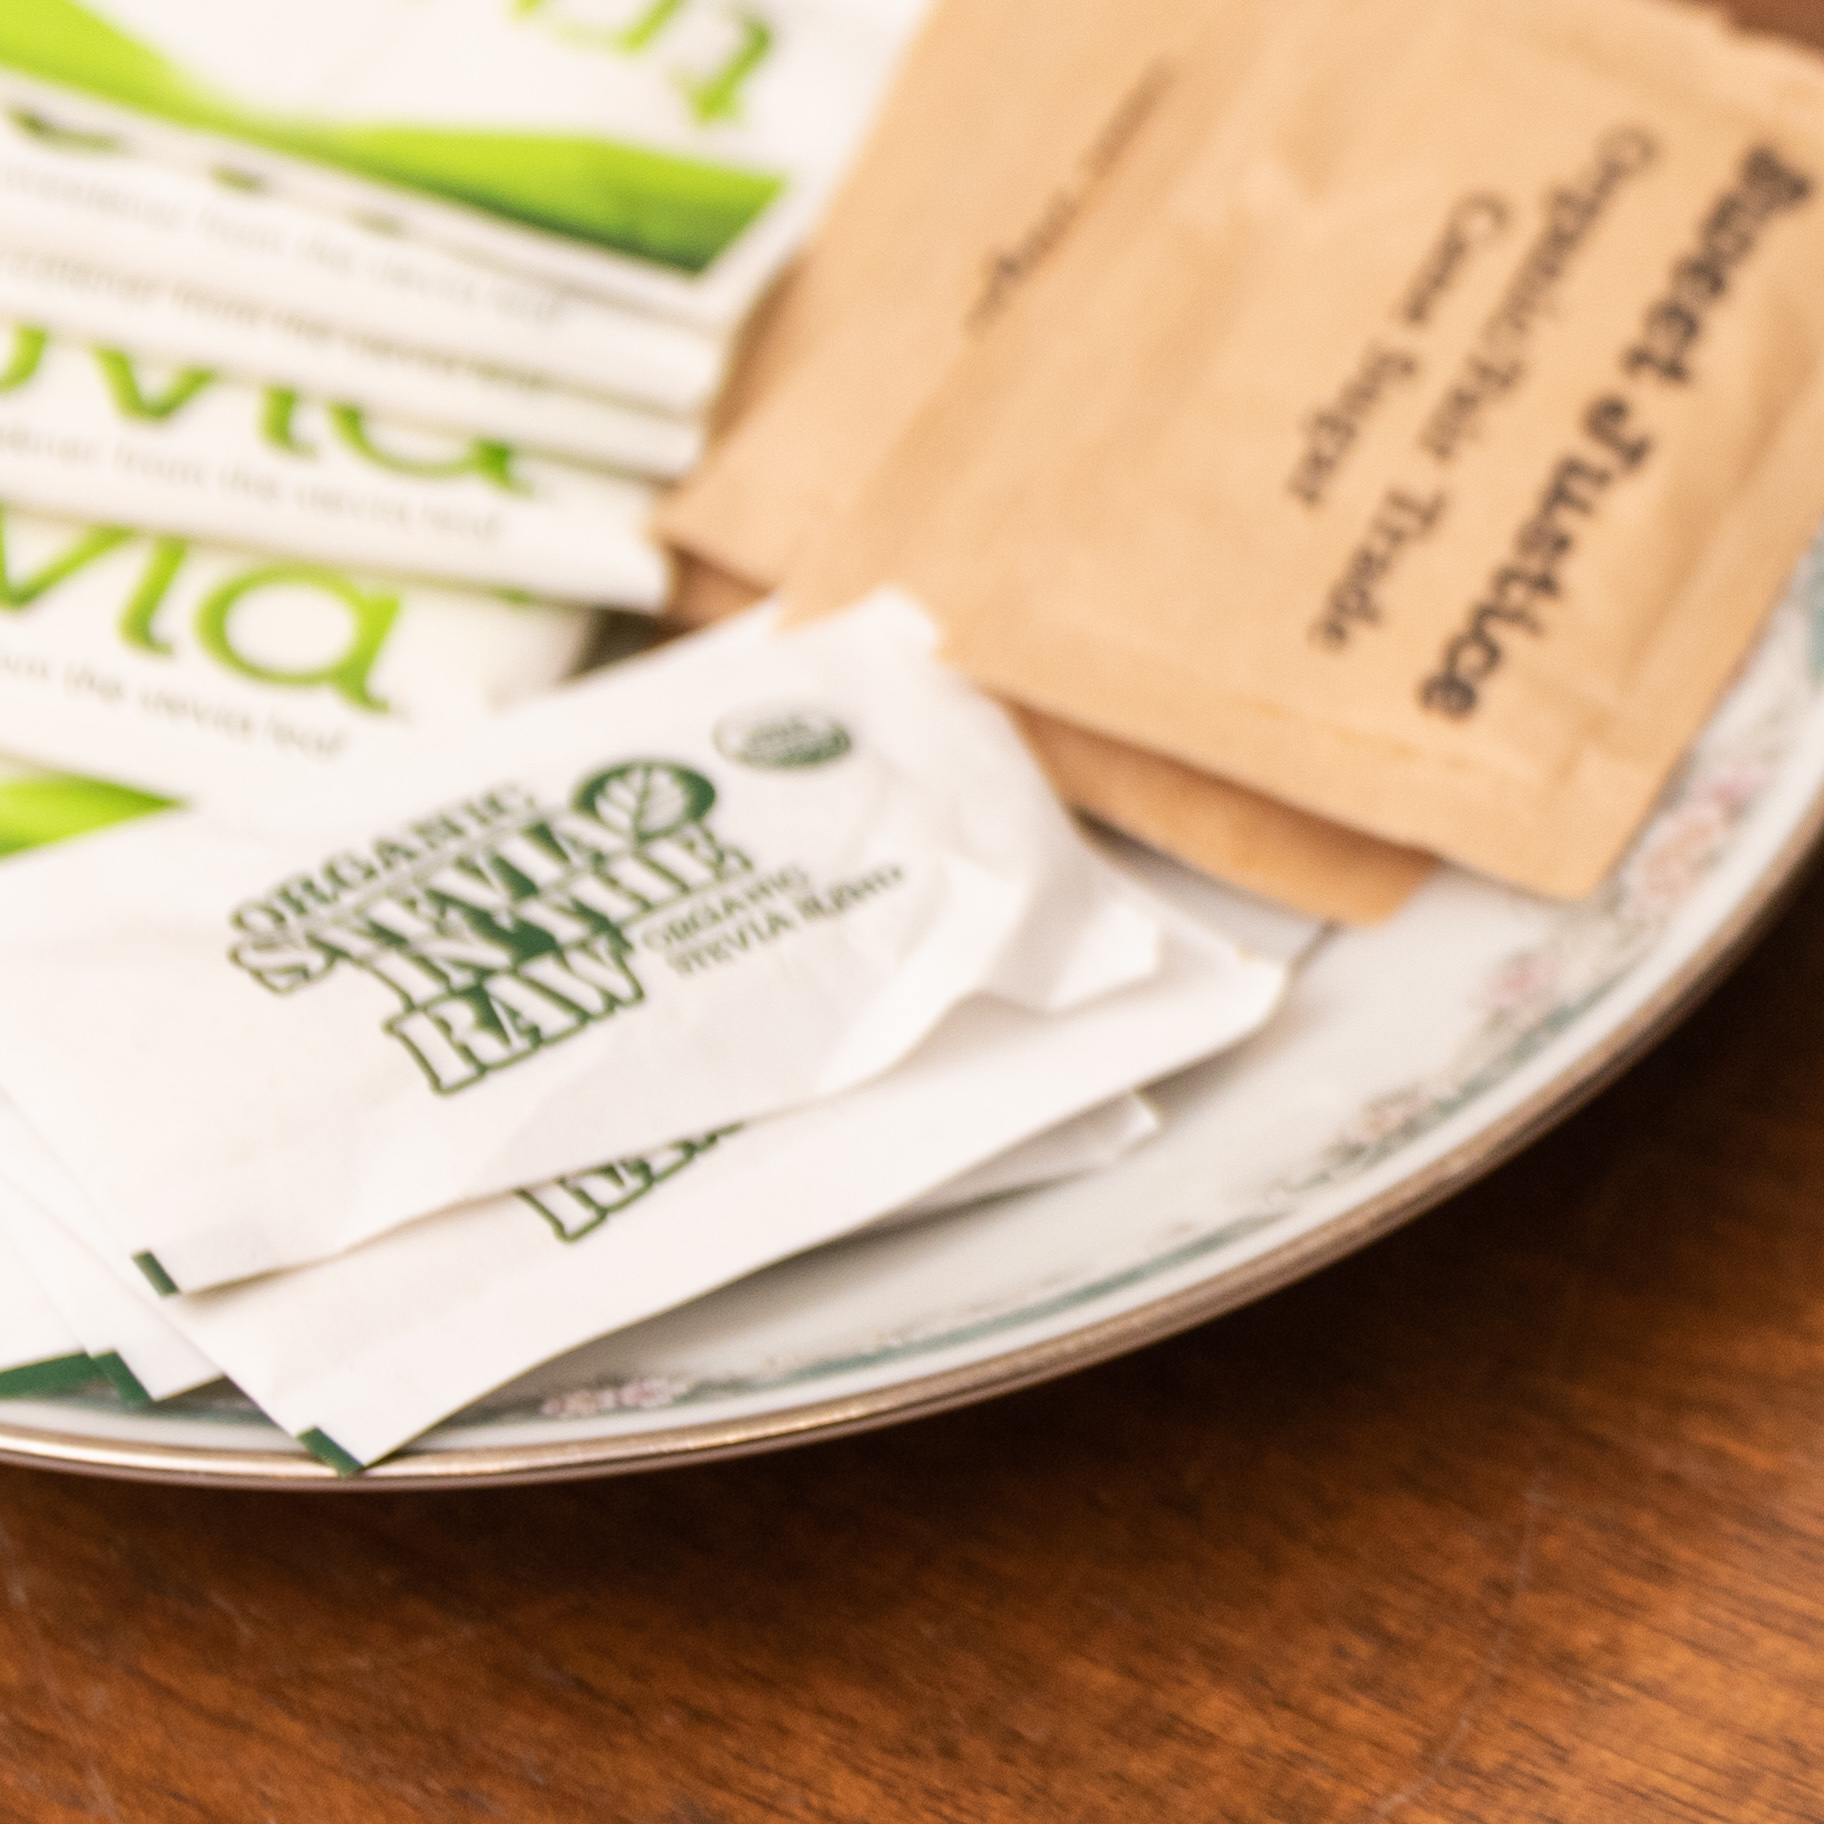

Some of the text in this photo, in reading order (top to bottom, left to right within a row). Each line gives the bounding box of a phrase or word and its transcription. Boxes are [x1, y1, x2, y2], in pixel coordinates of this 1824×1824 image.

[1285, 344, 1420, 510] Sugar
[1311, 482, 1447, 653] Trade
[1418, 396, 1653, 723] Justice
[228, 778, 537, 938] ORGANIC
[228, 816, 620, 993] STEVIA
[360, 821, 754, 1008] IN THE
[382, 938, 650, 1096] RAW
